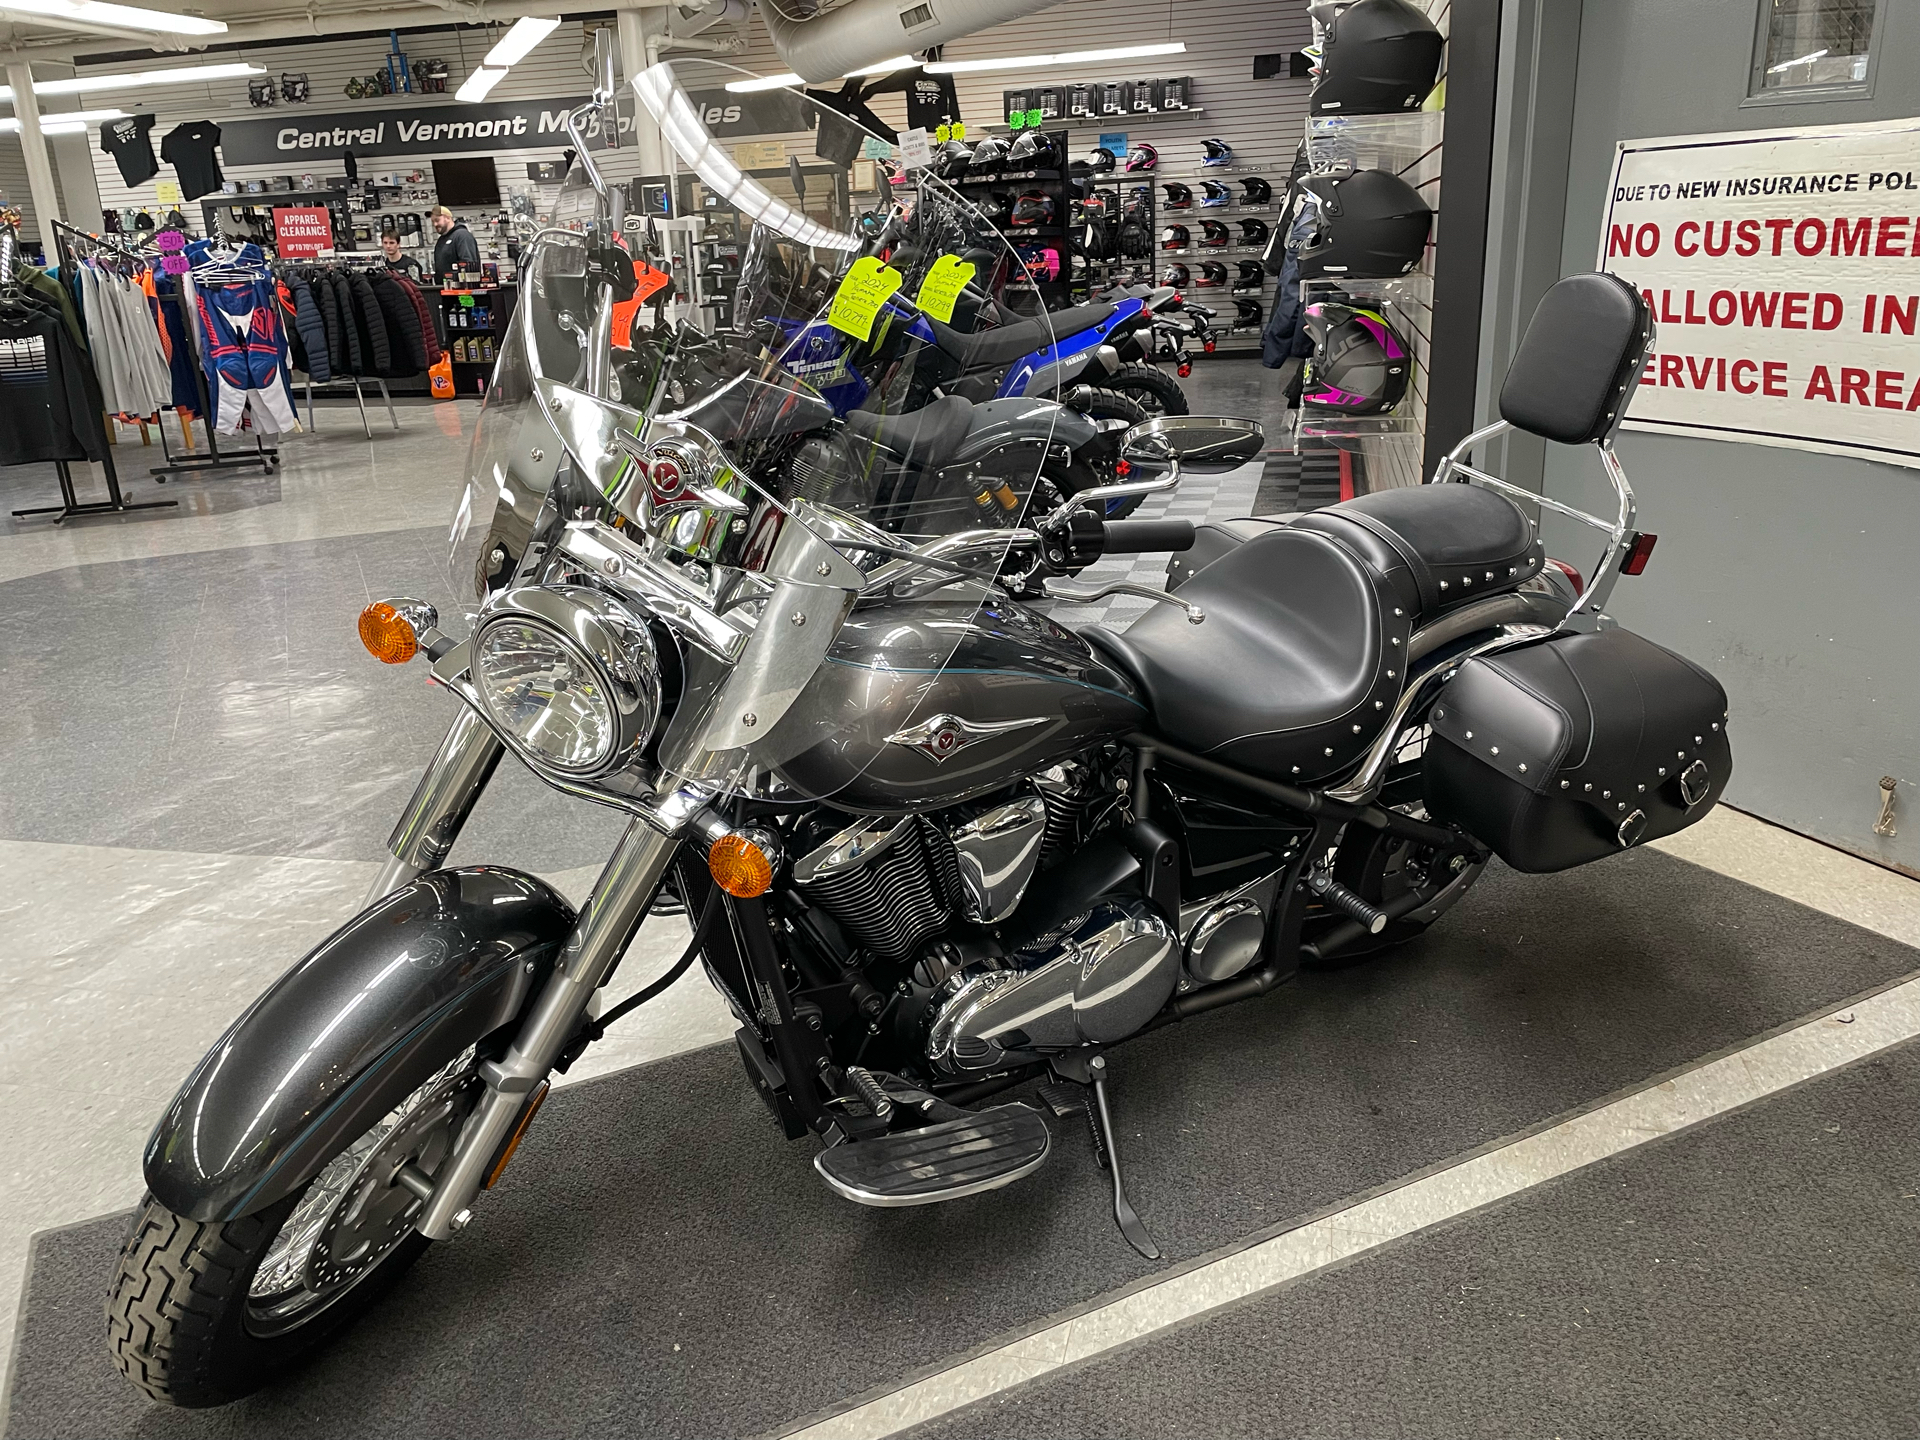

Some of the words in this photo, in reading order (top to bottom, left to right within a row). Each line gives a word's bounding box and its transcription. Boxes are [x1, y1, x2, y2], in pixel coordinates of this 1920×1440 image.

[276, 122, 385, 150] Central
[396, 115, 528, 142] Vermont
[1616, 185, 1645, 202] DUE
[1649, 183, 1671, 201] TO
[1676, 180, 1721, 199] NEW
[1725, 173, 1860, 196] INSURANCE
[284, 214, 321, 225] APPAREL
[280, 226, 328, 237] CLEARANCE
[1608, 222, 1661, 257] NO
[295, 243, 303, 251] TO
[167, 259, 184, 270] OFF
[861, 273, 890, 291] 2024
[1862, 294, 1920, 336] IN
[0, 334, 44, 345] OLARIS
[1064, 352, 1089, 367] YAMAHA
[1638, 353, 1789, 398] ERVICE
